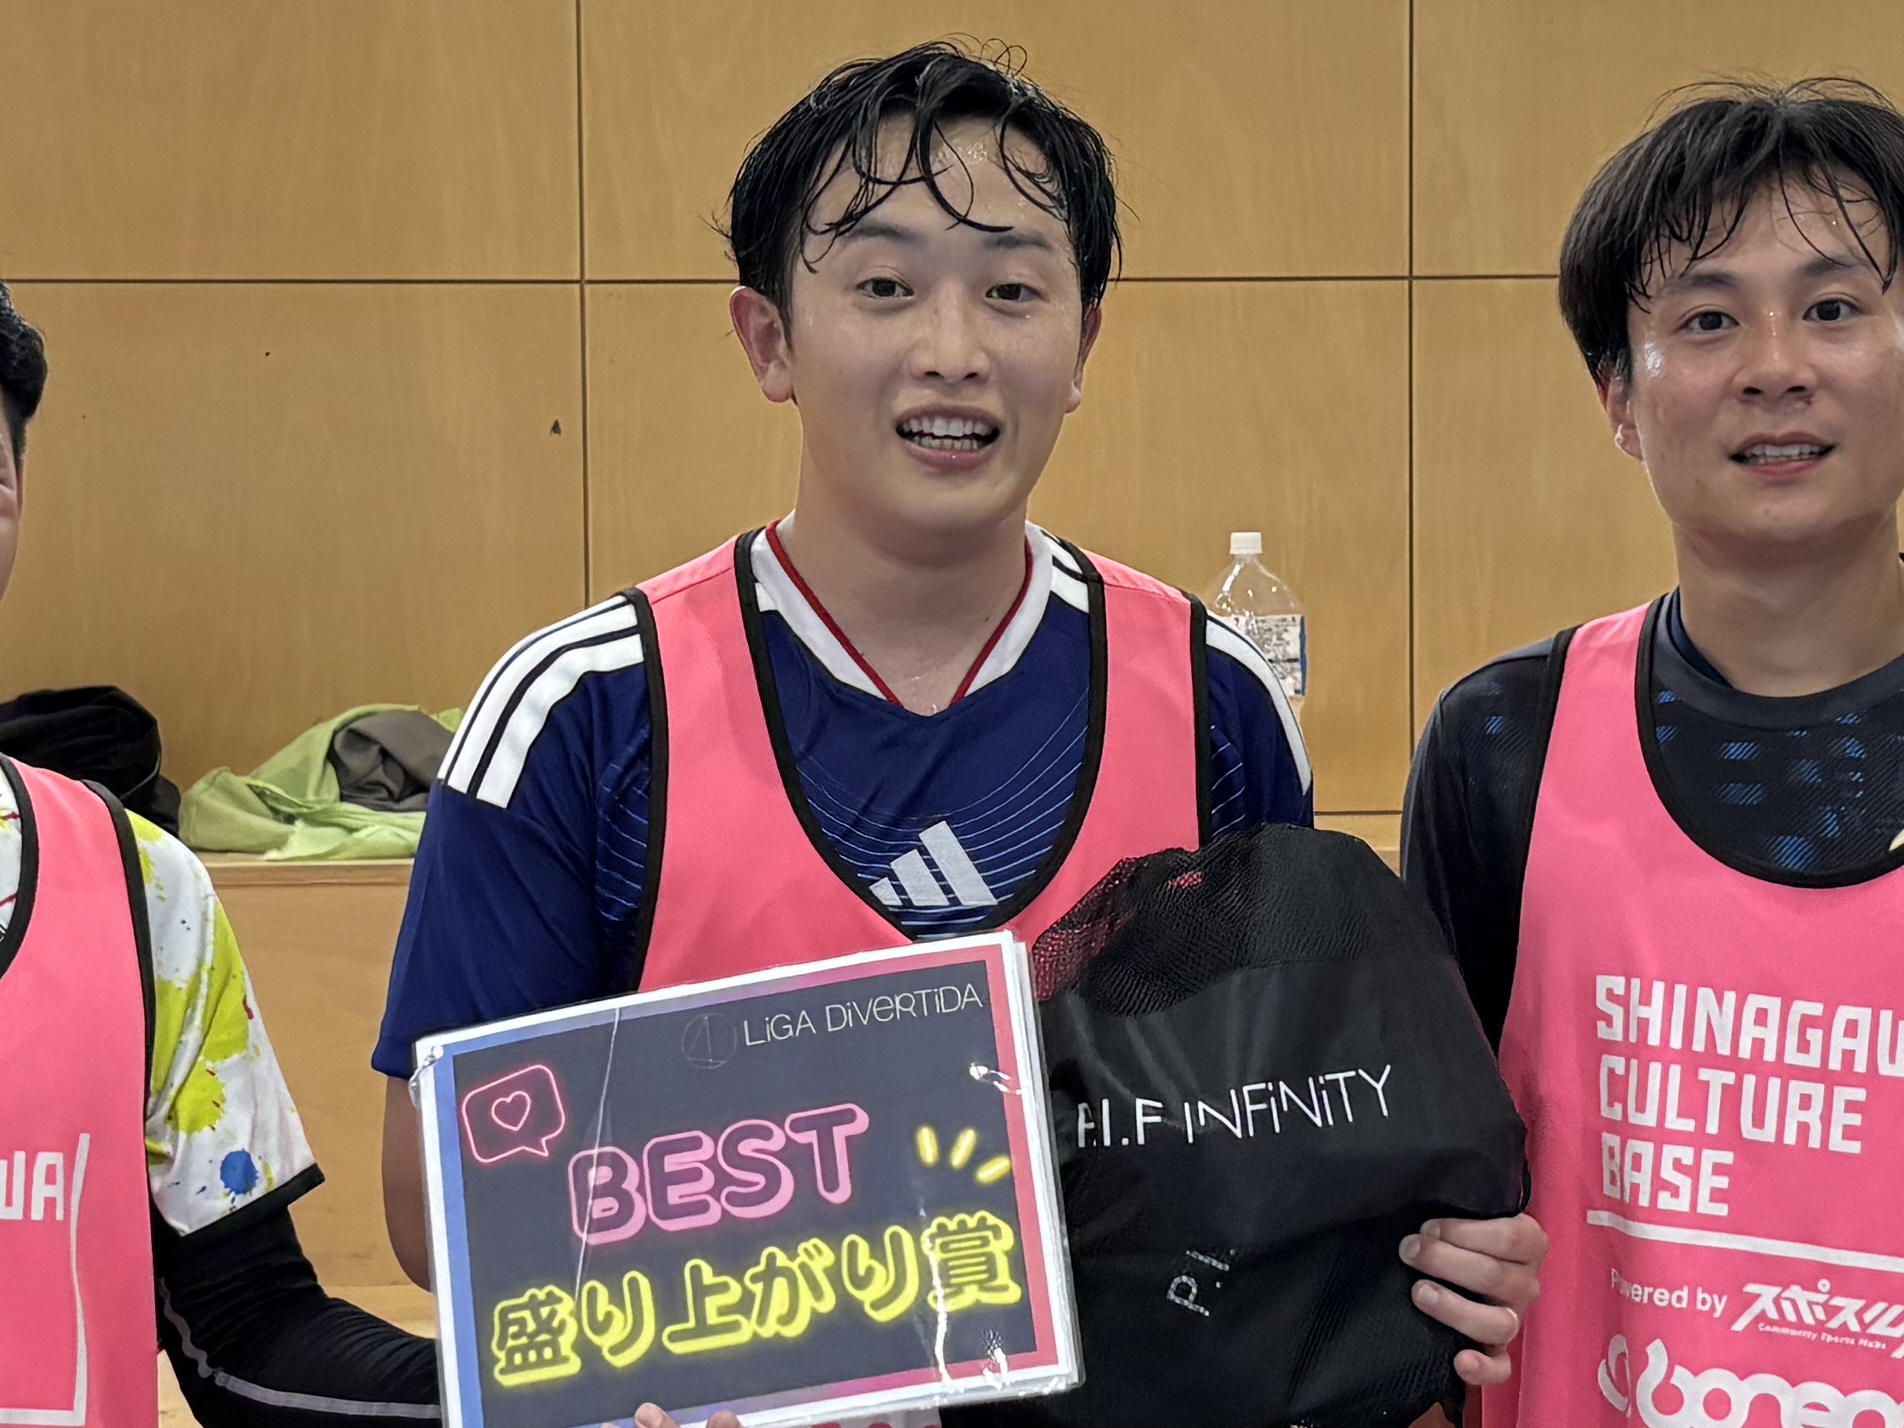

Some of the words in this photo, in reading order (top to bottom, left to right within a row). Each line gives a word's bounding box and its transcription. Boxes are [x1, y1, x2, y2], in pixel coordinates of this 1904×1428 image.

[1599, 1053, 1867, 1154] CULTURE
[567, 1102, 870, 1246] BEST
[1601, 1131, 1735, 1217] BASE
[492, 1210, 1022, 1388] 盛り上がり賞
[1696, 1286, 1728, 1319] by
